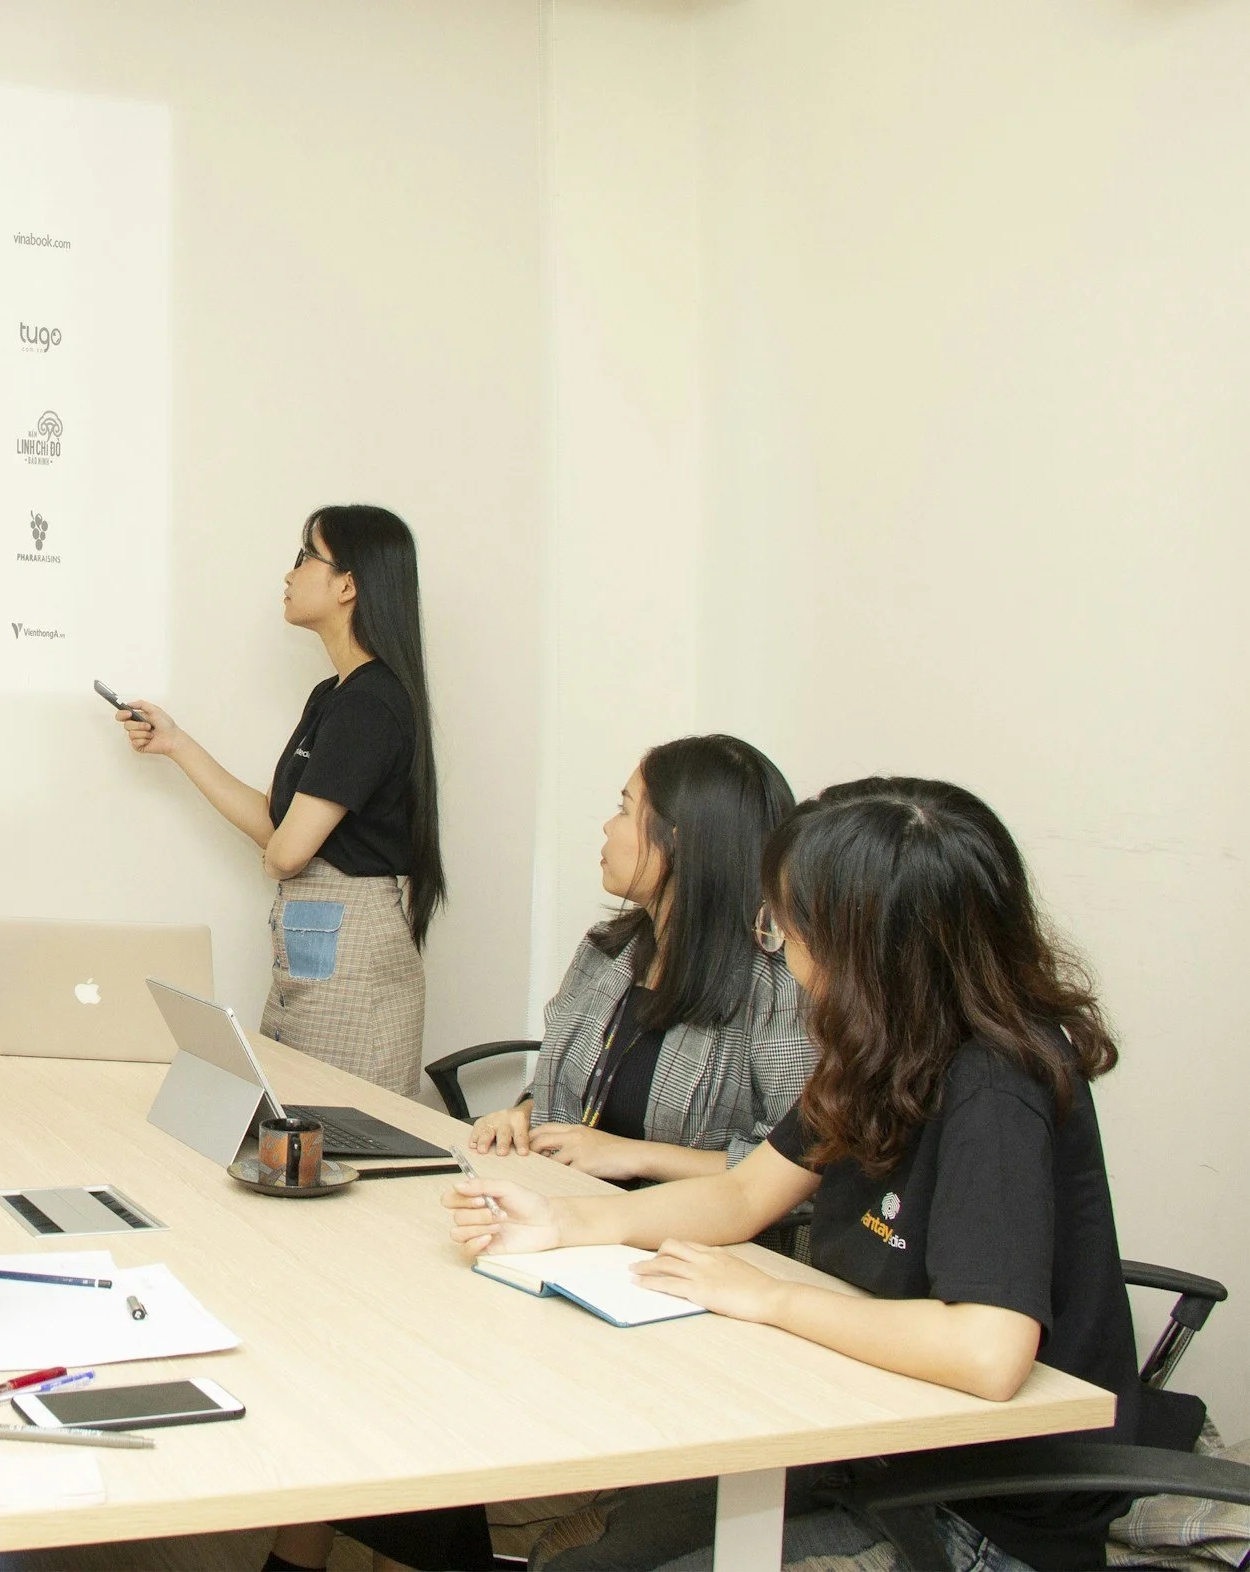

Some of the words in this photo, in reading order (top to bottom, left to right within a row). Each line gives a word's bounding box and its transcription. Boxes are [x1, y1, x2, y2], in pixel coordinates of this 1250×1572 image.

[13, 231, 72, 250] vinabook.com
[19, 321, 62, 353] tugo
[16, 438, 35, 455] LINH
